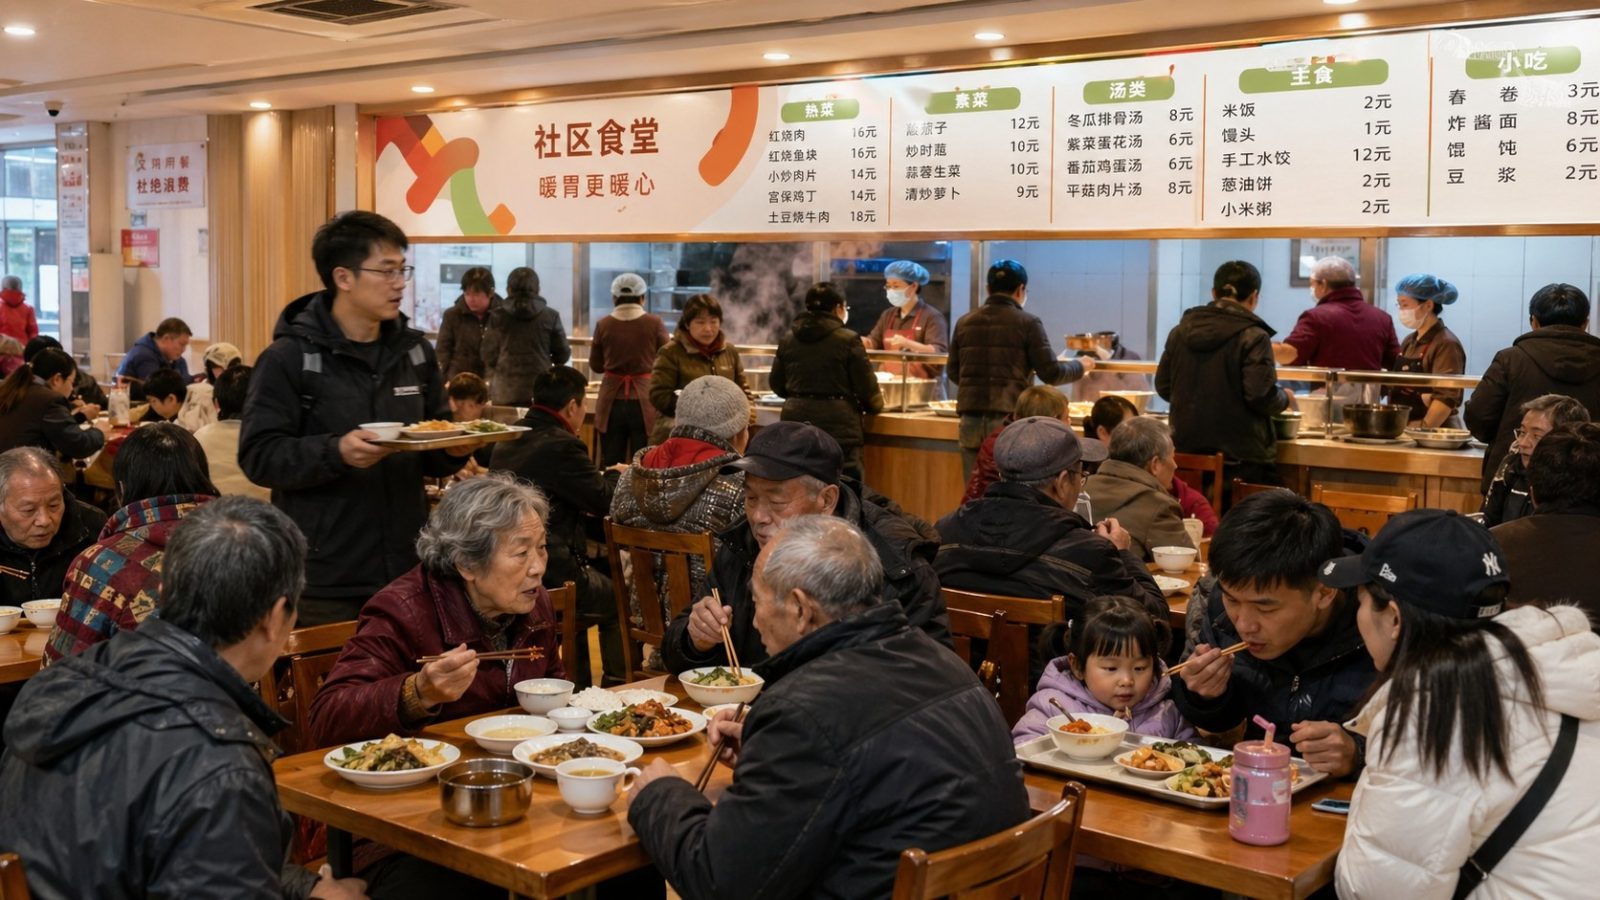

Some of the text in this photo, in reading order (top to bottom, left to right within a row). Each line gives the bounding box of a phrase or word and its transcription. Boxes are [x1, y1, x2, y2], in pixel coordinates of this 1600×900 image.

[1498, 51, 1548, 72] 小吃
[1290, 65, 1334, 86] 主食
[1109, 80, 1146, 99] 汤类
[1568, 82, 1600, 98] 3元
[955, 92, 988, 108] 素菜
[1222, 94, 1392, 118] 米饭 2元
[805, 102, 834, 118] 热菜
[1068, 107, 1194, 127] 冬瓜排骨汤 8元
[1567, 109, 1599, 126] 8元
[1010, 116, 1040, 130] 12元
[1222, 120, 1392, 143] 馒头 1元
[534, 117, 659, 159] 社区食堂
[769, 126, 877, 142] 红烧肉 16元
[1067, 132, 1193, 151] 紫菜蛋花汤 6元
[768, 146, 877, 162] 红烧鱼块 16元
[1010, 139, 1040, 152] 10元
[1566, 137, 1598, 153] 6元
[1067, 156, 1193, 174] 番茄鸡蛋汤 6元
[1222, 146, 1391, 167] 手工水饺 12元
[768, 168, 877, 183] 小炒肉片 14元
[905, 162, 1039, 179] 蒜蓉生菜 10元
[1565, 164, 1597, 180] 2元
[137, 176, 189, 194] 杜绝浪费
[539, 172, 655, 199] 暖胃更暖心
[1066, 180, 1192, 198] 平菇肉片汤 8元
[1222, 173, 1391, 192] 葱油饼 2元
[768, 189, 876, 203] 宫保鸡丁 14元
[905, 185, 1039, 201] 清炒萝卜 9元
[768, 210, 876, 223] 土豆烧牛肉 18元
[1221, 199, 1390, 217] 小米粥 2元
[1482, 552, 1501, 576] NY
